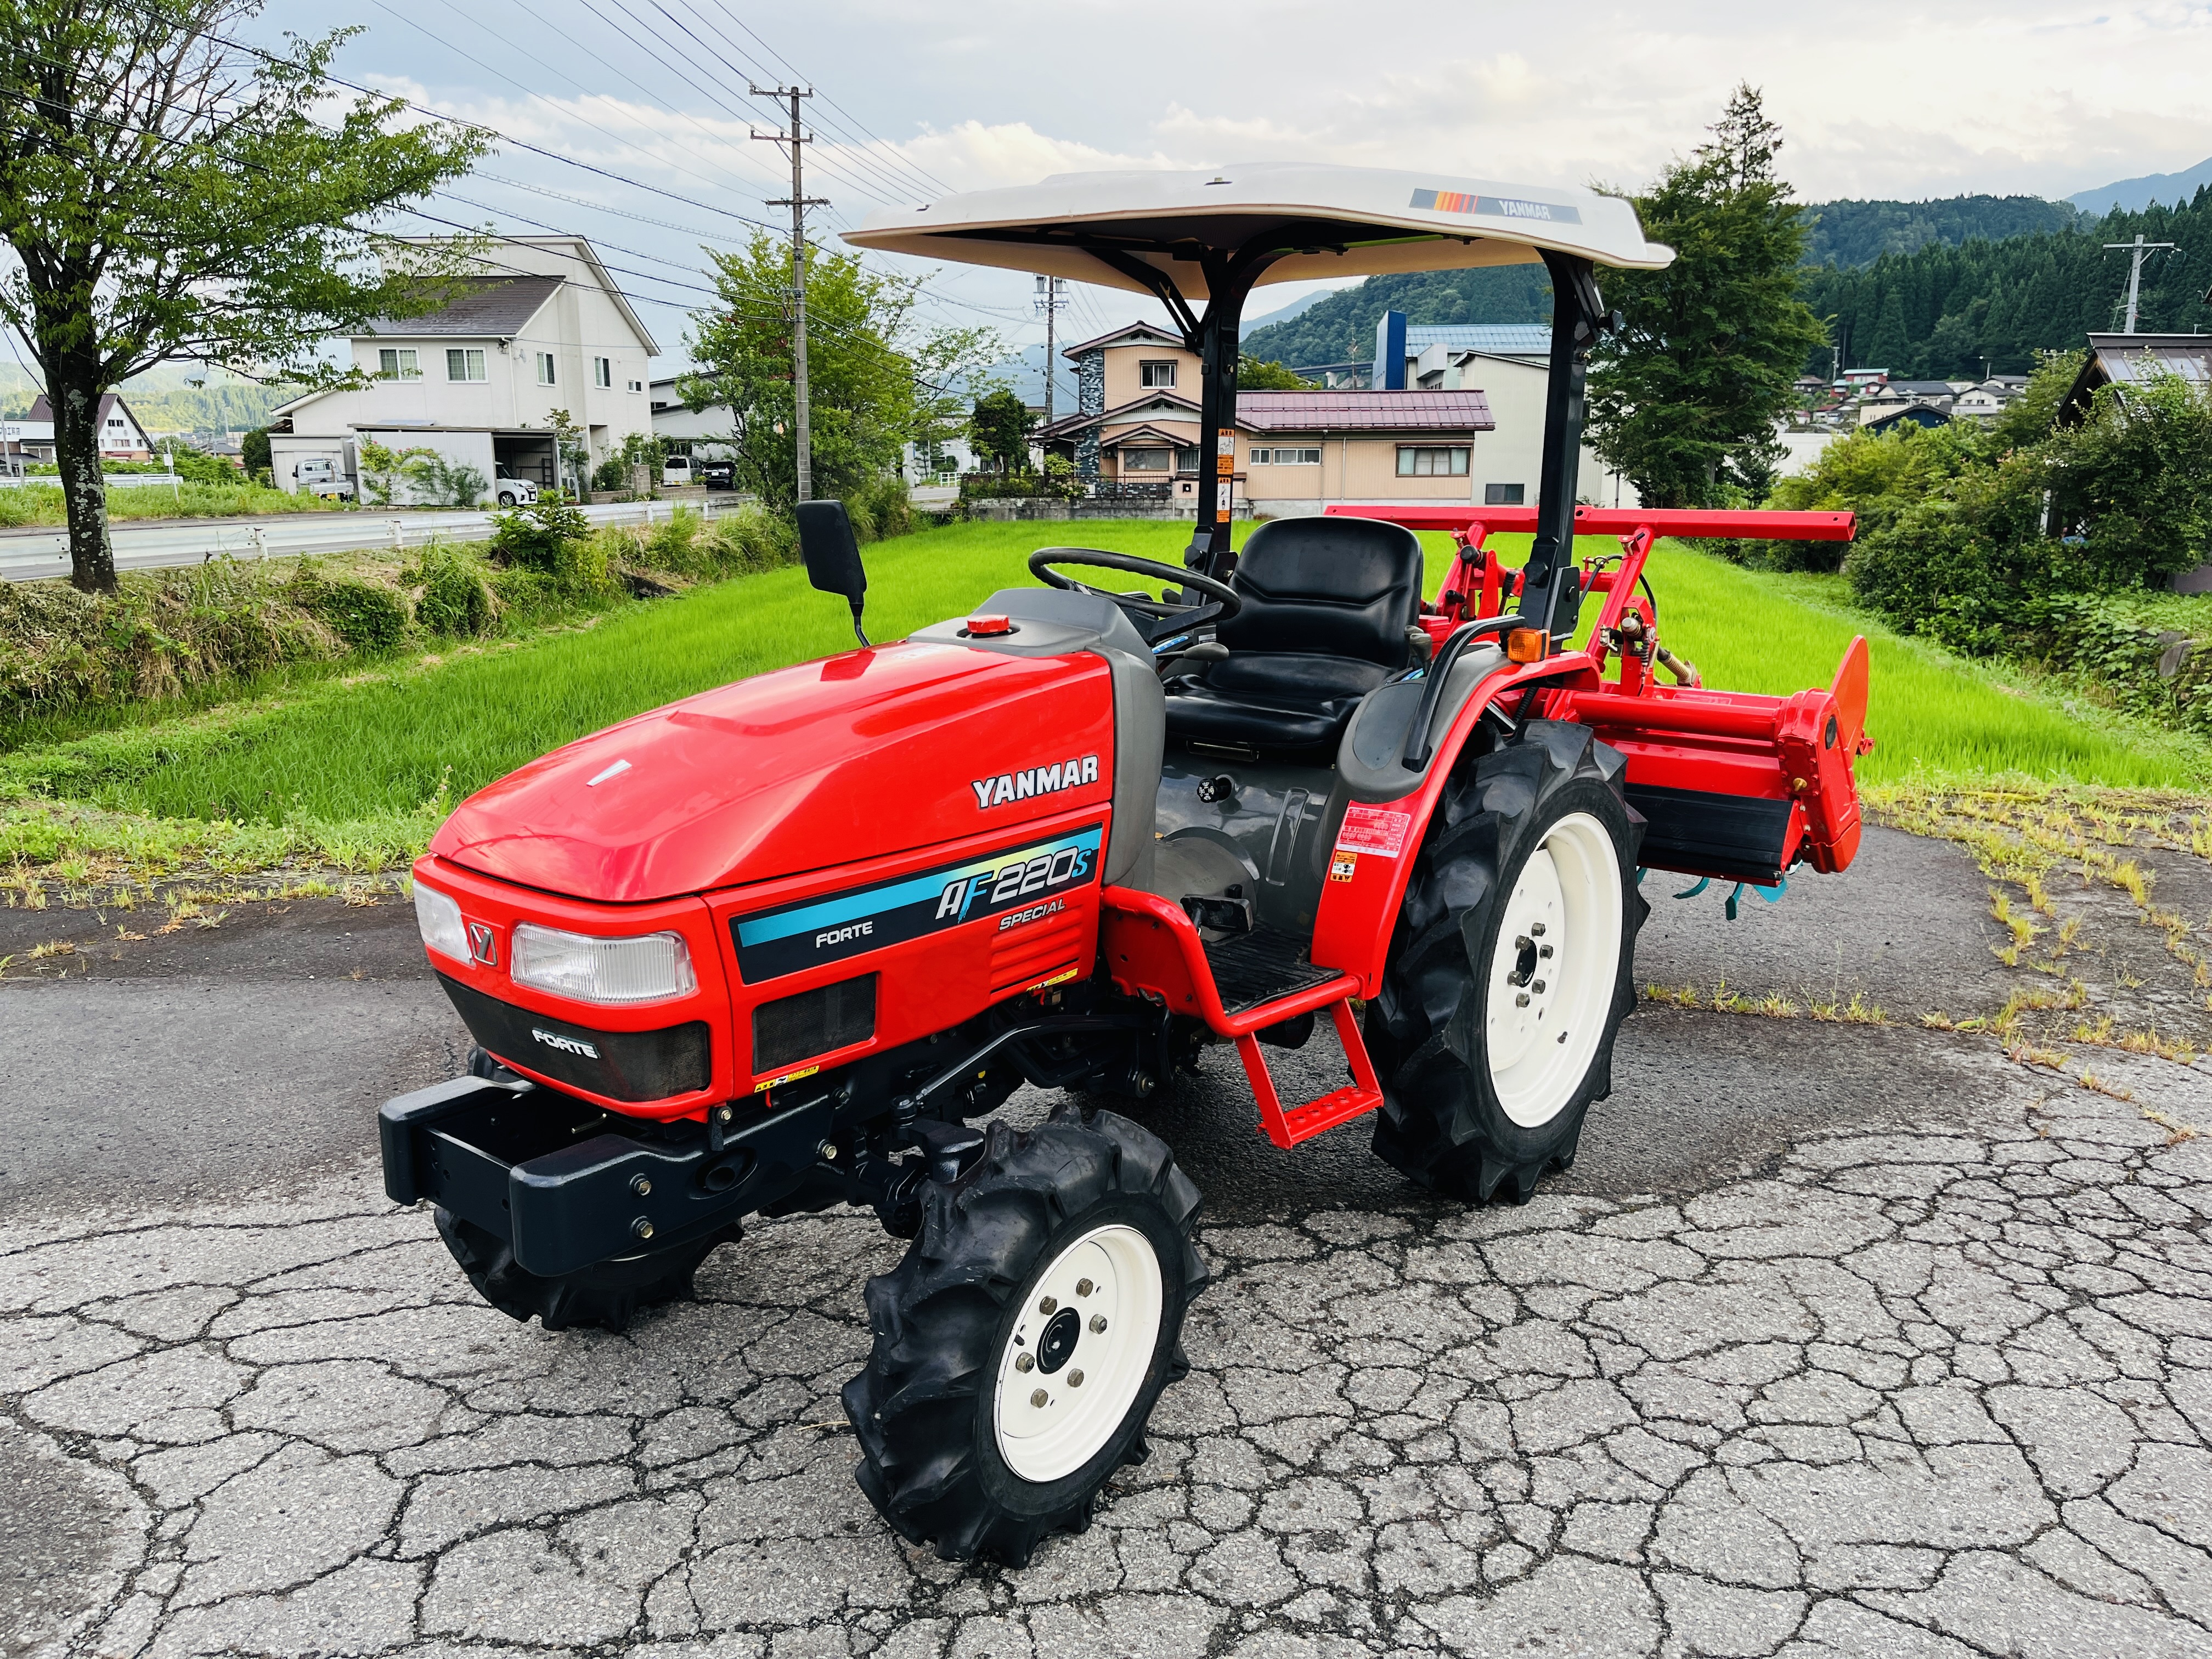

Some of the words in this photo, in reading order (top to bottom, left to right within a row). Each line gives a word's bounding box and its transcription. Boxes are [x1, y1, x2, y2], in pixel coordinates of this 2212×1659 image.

[1498, 200, 1551, 220] YANMAR
[972, 755, 1098, 809] YANMAR
[998, 899, 1065, 931] SPECIAL
[816, 921, 873, 949] FORTE
[532, 1029, 599, 1059] FORTE
